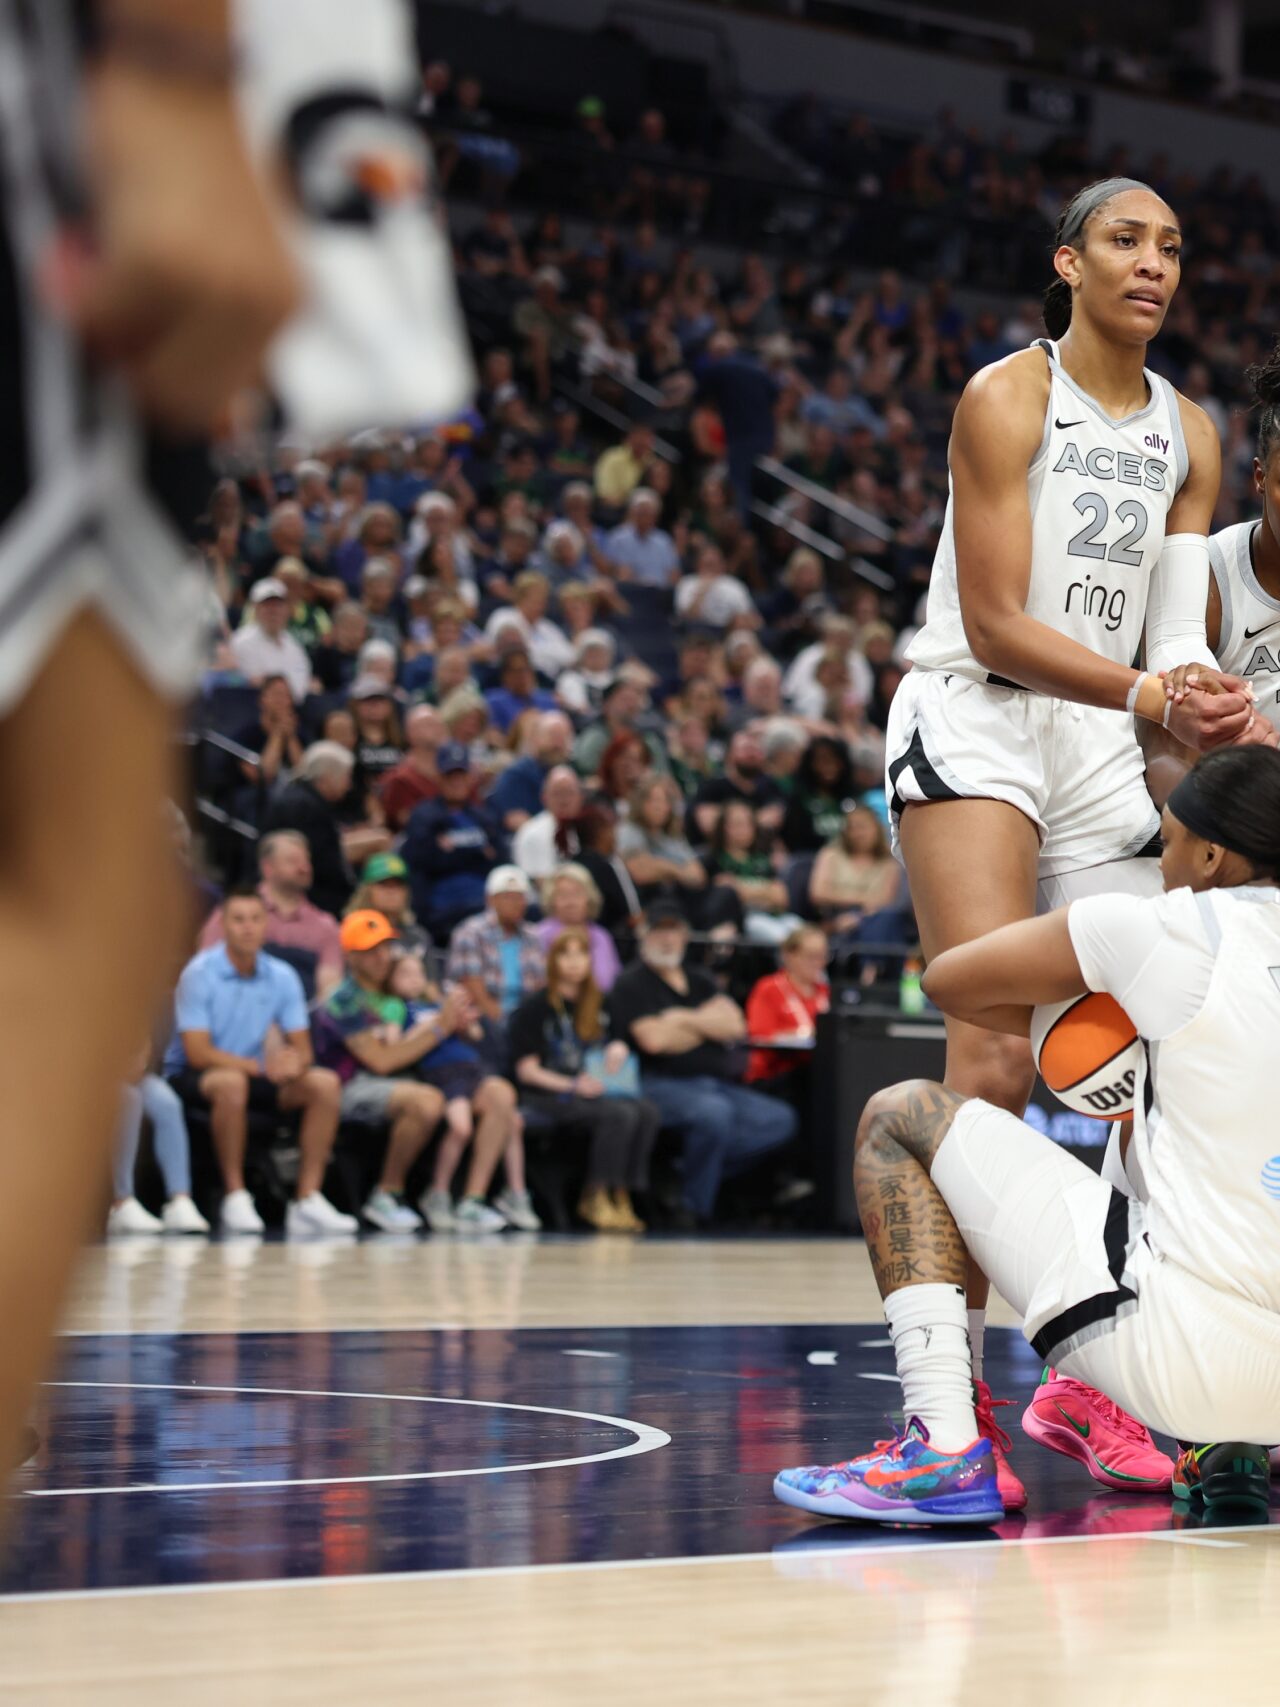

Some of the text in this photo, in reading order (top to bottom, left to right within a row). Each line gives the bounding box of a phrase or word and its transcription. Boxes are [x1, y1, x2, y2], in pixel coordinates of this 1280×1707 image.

[1053, 442, 1168, 492] ACES
[1144, 433, 1169, 455] ally
[1067, 492, 1148, 567] 22
[1064, 574, 1126, 632] ring
